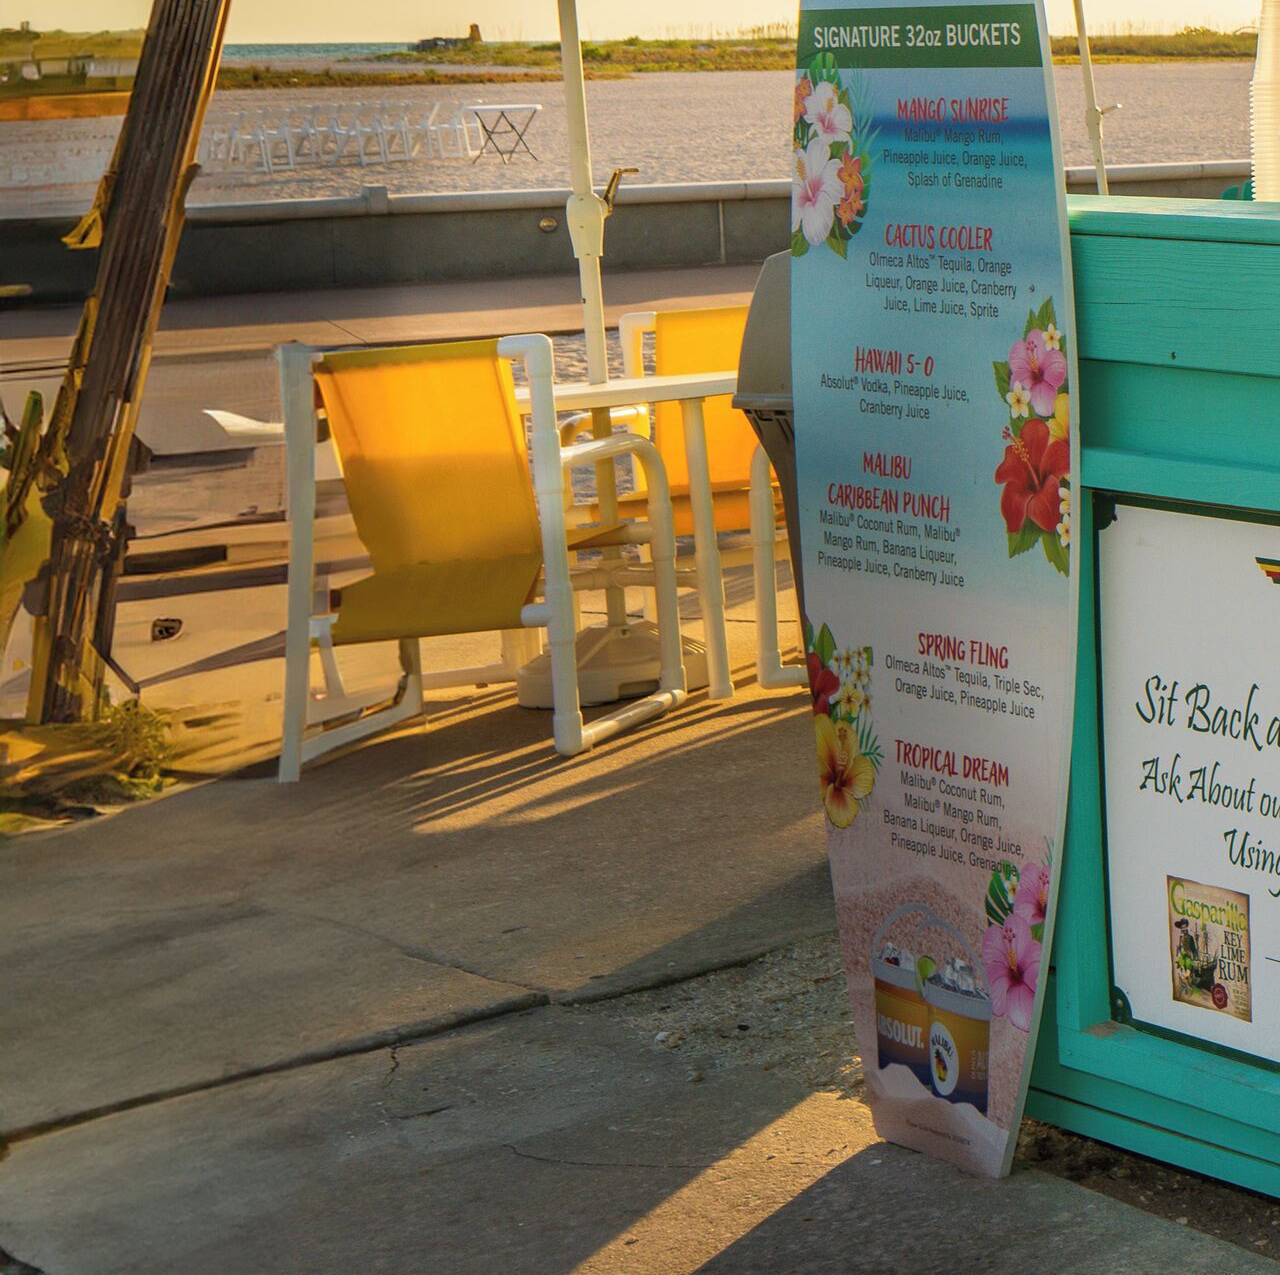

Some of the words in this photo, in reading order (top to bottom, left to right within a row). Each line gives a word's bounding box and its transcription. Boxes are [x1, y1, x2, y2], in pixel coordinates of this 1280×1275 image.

[814, 25, 900, 48] SIGNATURE
[906, 24, 941, 46] 32oz
[946, 23, 1020, 46] BUCKETS
[896, 97, 946, 122] MANGO
[951, 98, 1009, 123] SUNRISE
[883, 149, 929, 168] Pineapple
[932, 151, 959, 167] Juice,
[962, 151, 997, 169] Orange
[999, 152, 1027, 169] Juice,
[908, 171, 939, 188] Splash
[942, 173, 951, 186] of
[954, 174, 1003, 189] Grenadine
[885, 223, 935, 250] CACTUS
[940, 226, 993, 252] COOLER
[869, 252, 904, 268] Olmeca
[938, 256, 975, 274] Tequila,
[978, 257, 1012, 276] Orange
[905, 276, 938, 294] Orange
[941, 278, 968, 295] Juice,
[971, 281, 1017, 300] Cranberry
[883, 296, 911, 313] Juice,
[914, 298, 937, 313] Lime
[939, 300, 967, 316] Juice,
[970, 302, 999, 319] Sprite
[854, 346, 902, 375] HAWAII
[861, 377, 891, 396] Vodka,
[894, 381, 939, 401] Pineapple
[941, 385, 970, 403] Juice,
[860, 398, 903, 419] Cranberry
[905, 404, 930, 419] Juice
[863, 451, 912, 480] MALIBU
[828, 483, 899, 514] CARIBBEAN
[903, 492, 950, 523] PUNCH
[856, 515, 894, 534] Coconut
[896, 520, 921, 539] Rum,
[824, 531, 853, 550] Mango
[856, 536, 880, 554] Rum,
[883, 540, 917, 558] Banana
[919, 544, 957, 567] Liqueur,
[818, 551, 862, 572] Pineapple
[864, 558, 891, 577] Juice,
[894, 563, 937, 587] Cranberry
[939, 570, 965, 587] Juice
[918, 632, 965, 662] SPRING
[970, 640, 1009, 669] FLING
[885, 654, 920, 675] Olmeca
[954, 667, 991, 689] Tequila,
[994, 674, 1020, 694] Triple
[1023, 681, 1045, 701] Sec,
[895, 677, 928, 700] Orange
[929, 687, 957, 705] Juice,
[960, 690, 1007, 715] Pineapple
[1009, 700, 1035, 719] Juice
[1135, 674, 1180, 727] Sit
[1185, 682, 1263, 752] Back
[894, 739, 959, 777] TROPICAL
[962, 755, 1009, 788] DREAM
[1139, 753, 1184, 803] Ask
[1186, 761, 1255, 814] About
[883, 809, 917, 830] Banana
[920, 817, 957, 842] Liqueur,
[960, 828, 994, 851] Orange
[996, 838, 1024, 859] Juice,
[891, 833, 936, 857] Pineapple
[938, 846, 966, 866] Juice,
[1224, 930, 1244, 949] KEY
[1220, 944, 1246, 965] LIME
[1218, 958, 1249, 984] RUM
